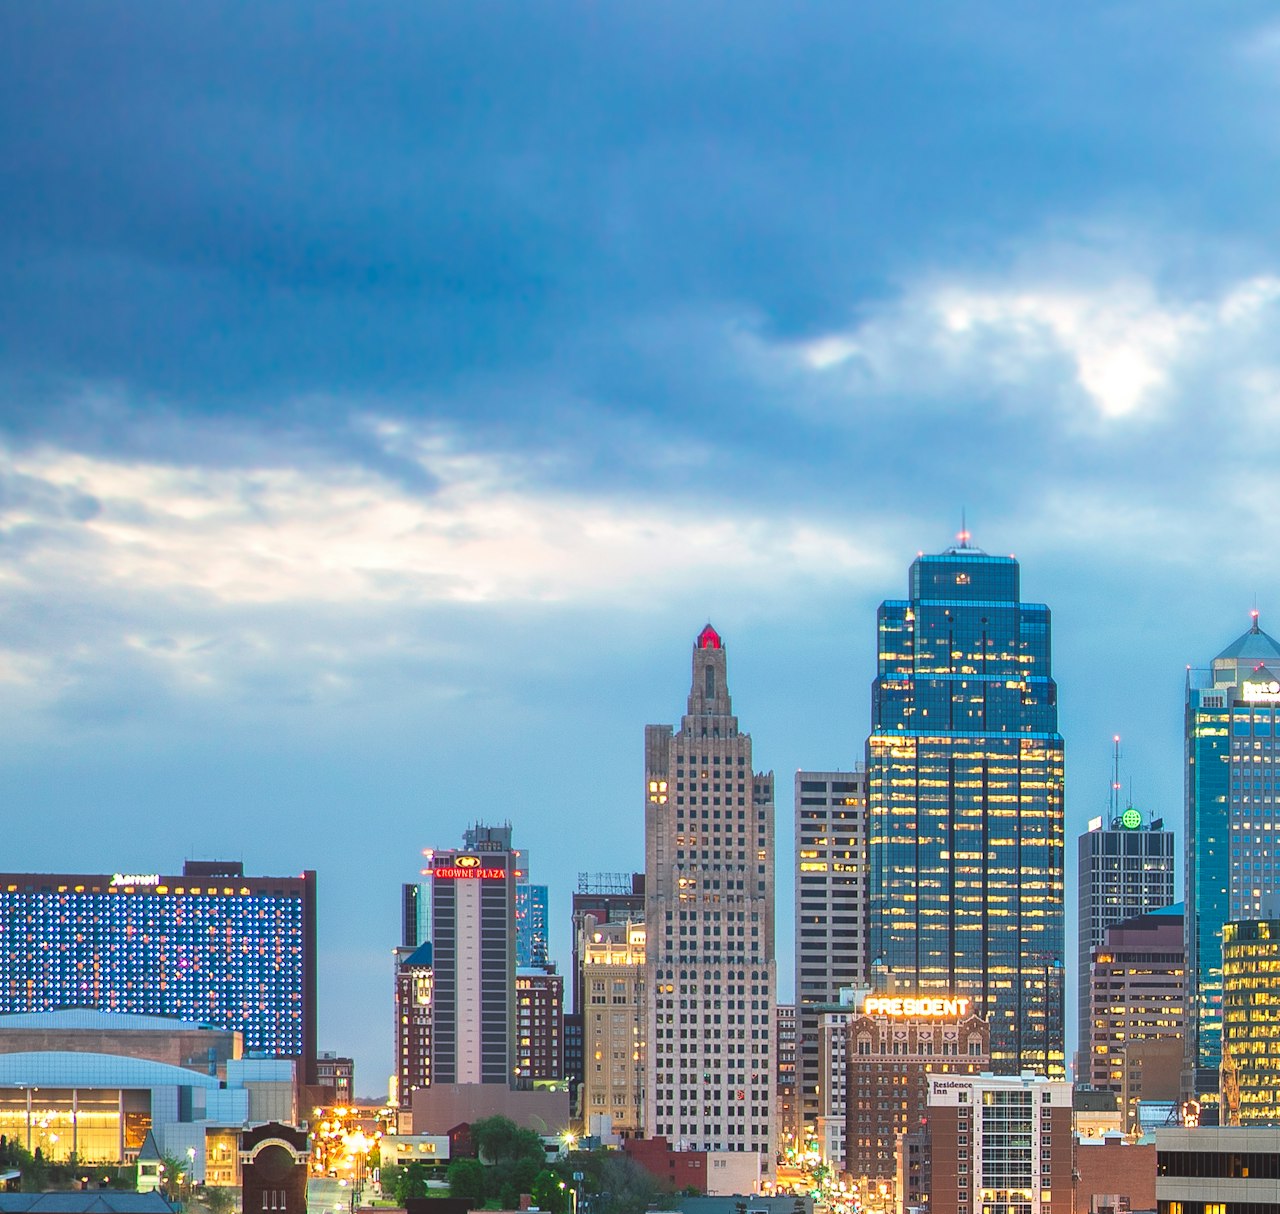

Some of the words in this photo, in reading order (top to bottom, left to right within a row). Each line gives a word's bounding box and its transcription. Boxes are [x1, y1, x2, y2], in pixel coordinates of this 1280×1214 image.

[436, 869, 474, 878] CROWNE
[476, 869, 506, 878] PLAZA
[865, 997, 970, 1016] PRESIDENT
[933, 1081, 973, 1089] Residence
[933, 1087, 948, 1095] Inn
